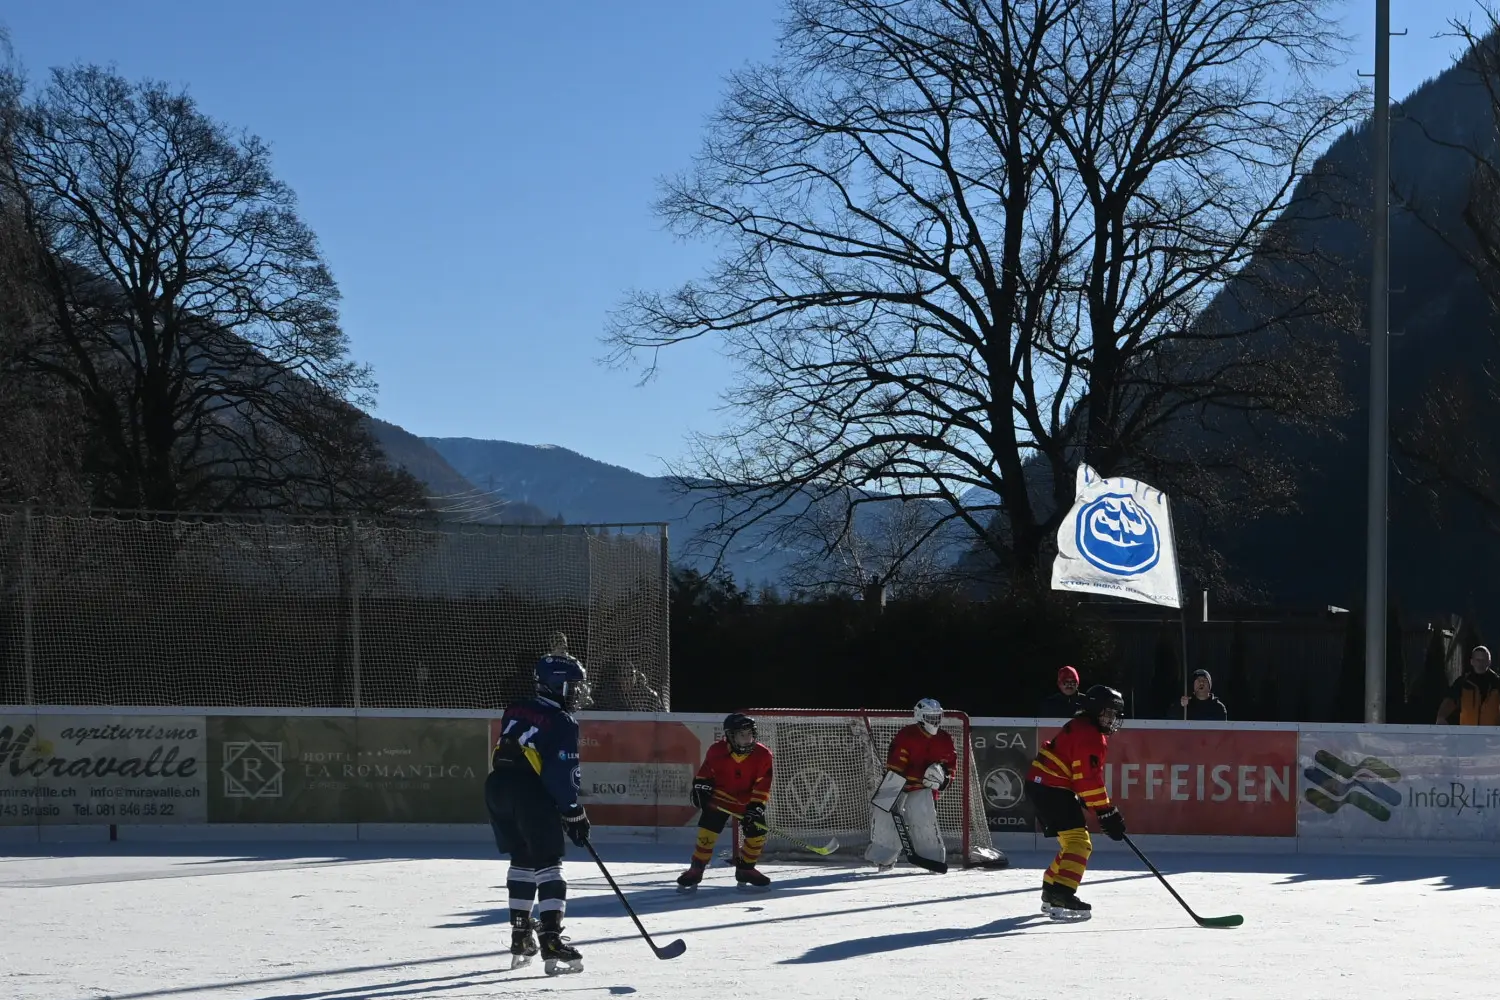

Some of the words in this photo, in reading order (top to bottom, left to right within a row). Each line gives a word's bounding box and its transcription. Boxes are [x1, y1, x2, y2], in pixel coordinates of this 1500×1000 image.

[60, 724, 199, 746] agriturismo
[995, 732, 1026, 749] SA
[304, 752, 353, 761] HOTEL
[240, 757, 265, 783] R
[305, 764, 331, 778] LA
[342, 764, 475, 779] ROMANTICA
[1104, 763, 1290, 802] IFFEISEN
[90, 786, 200, 798] info@miravalle.ch
[22, 804, 60, 816] Brusio
[73, 804, 92, 816] Tel.
[96, 804, 116, 816] 081
[120, 804, 140, 816] 846
[160, 804, 175, 816] 22
[987, 817, 1027, 826] KODA
